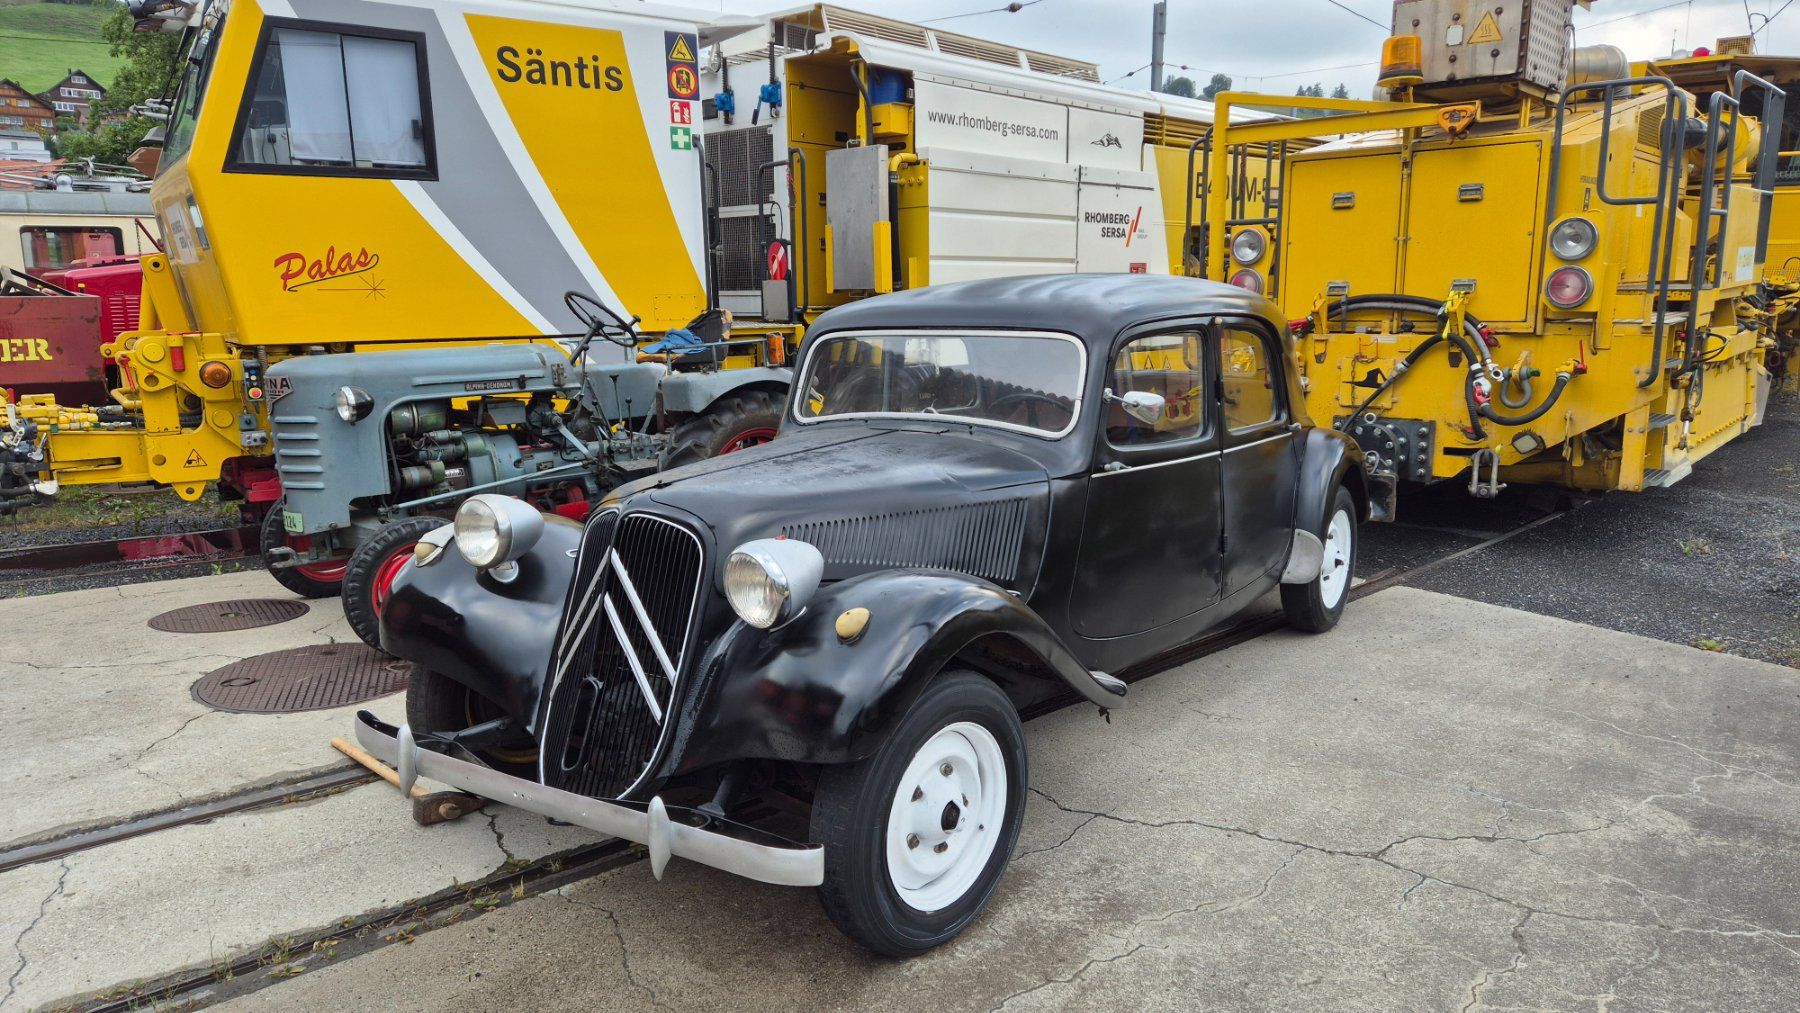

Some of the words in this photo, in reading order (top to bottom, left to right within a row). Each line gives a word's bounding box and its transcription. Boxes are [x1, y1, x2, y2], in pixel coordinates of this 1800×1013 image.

[497, 45, 624, 92] Säntis
[928, 110, 1059, 141] www.rhomberg-sersa.com
[1084, 211, 1131, 225] RHOMBERG
[1101, 227, 1127, 239] SERSA
[274, 245, 374, 292] Palas
